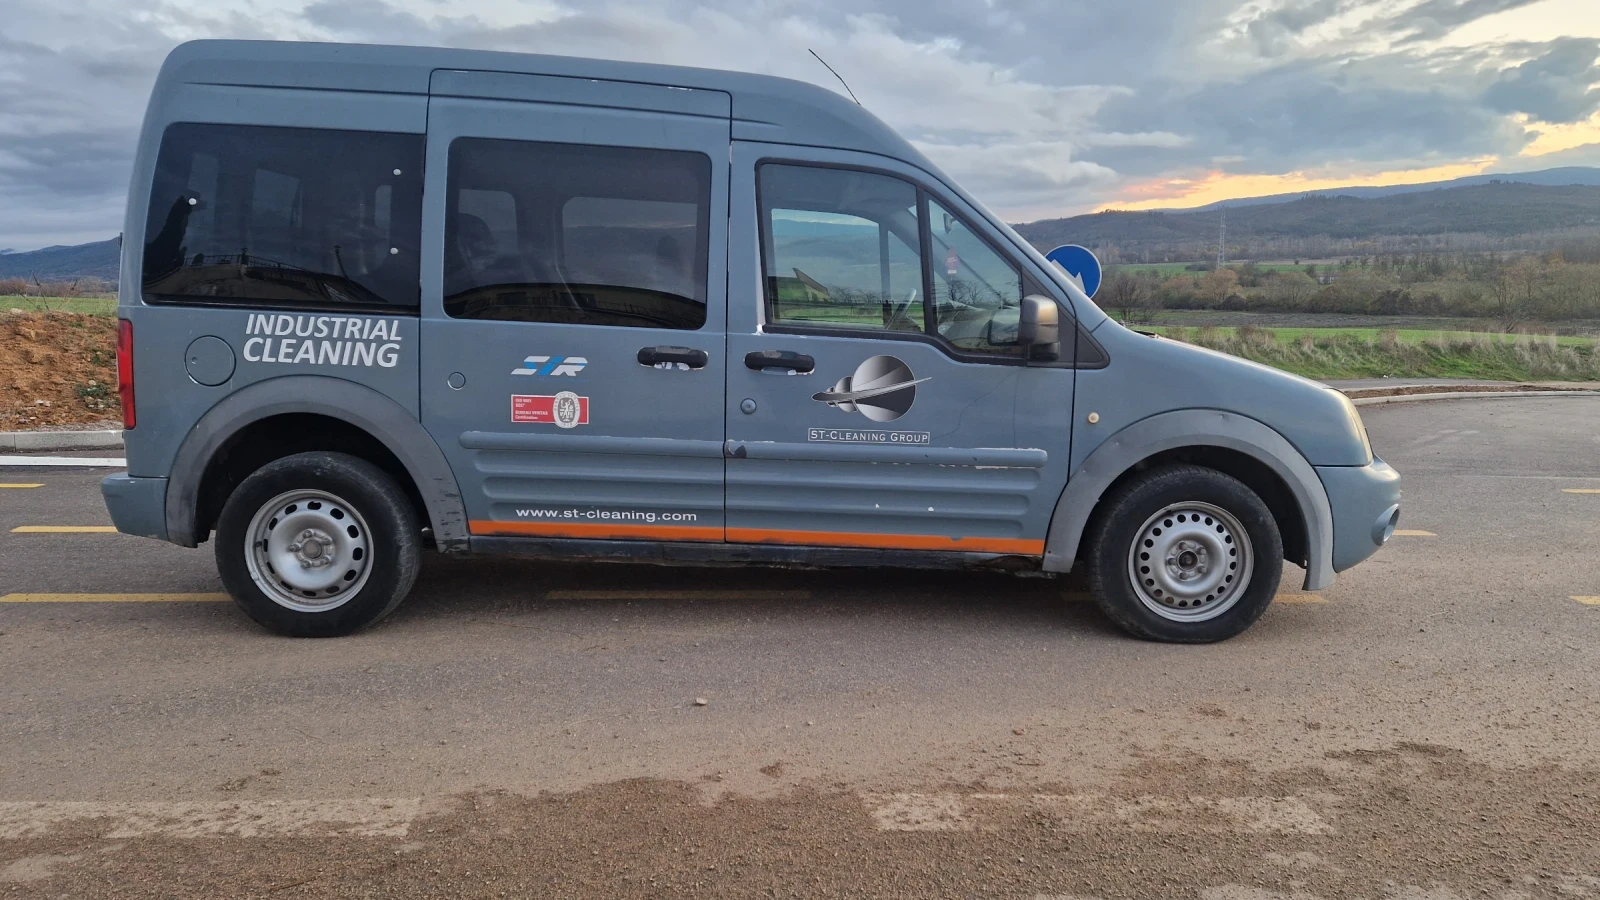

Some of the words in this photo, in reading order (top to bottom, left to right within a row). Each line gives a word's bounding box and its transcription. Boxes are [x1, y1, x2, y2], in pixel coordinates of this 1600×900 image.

[245, 314, 402, 341] INDUSTRIAL
[243, 337, 400, 368] CLEANING
[516, 508, 697, 523] www.st-cleaning.com
